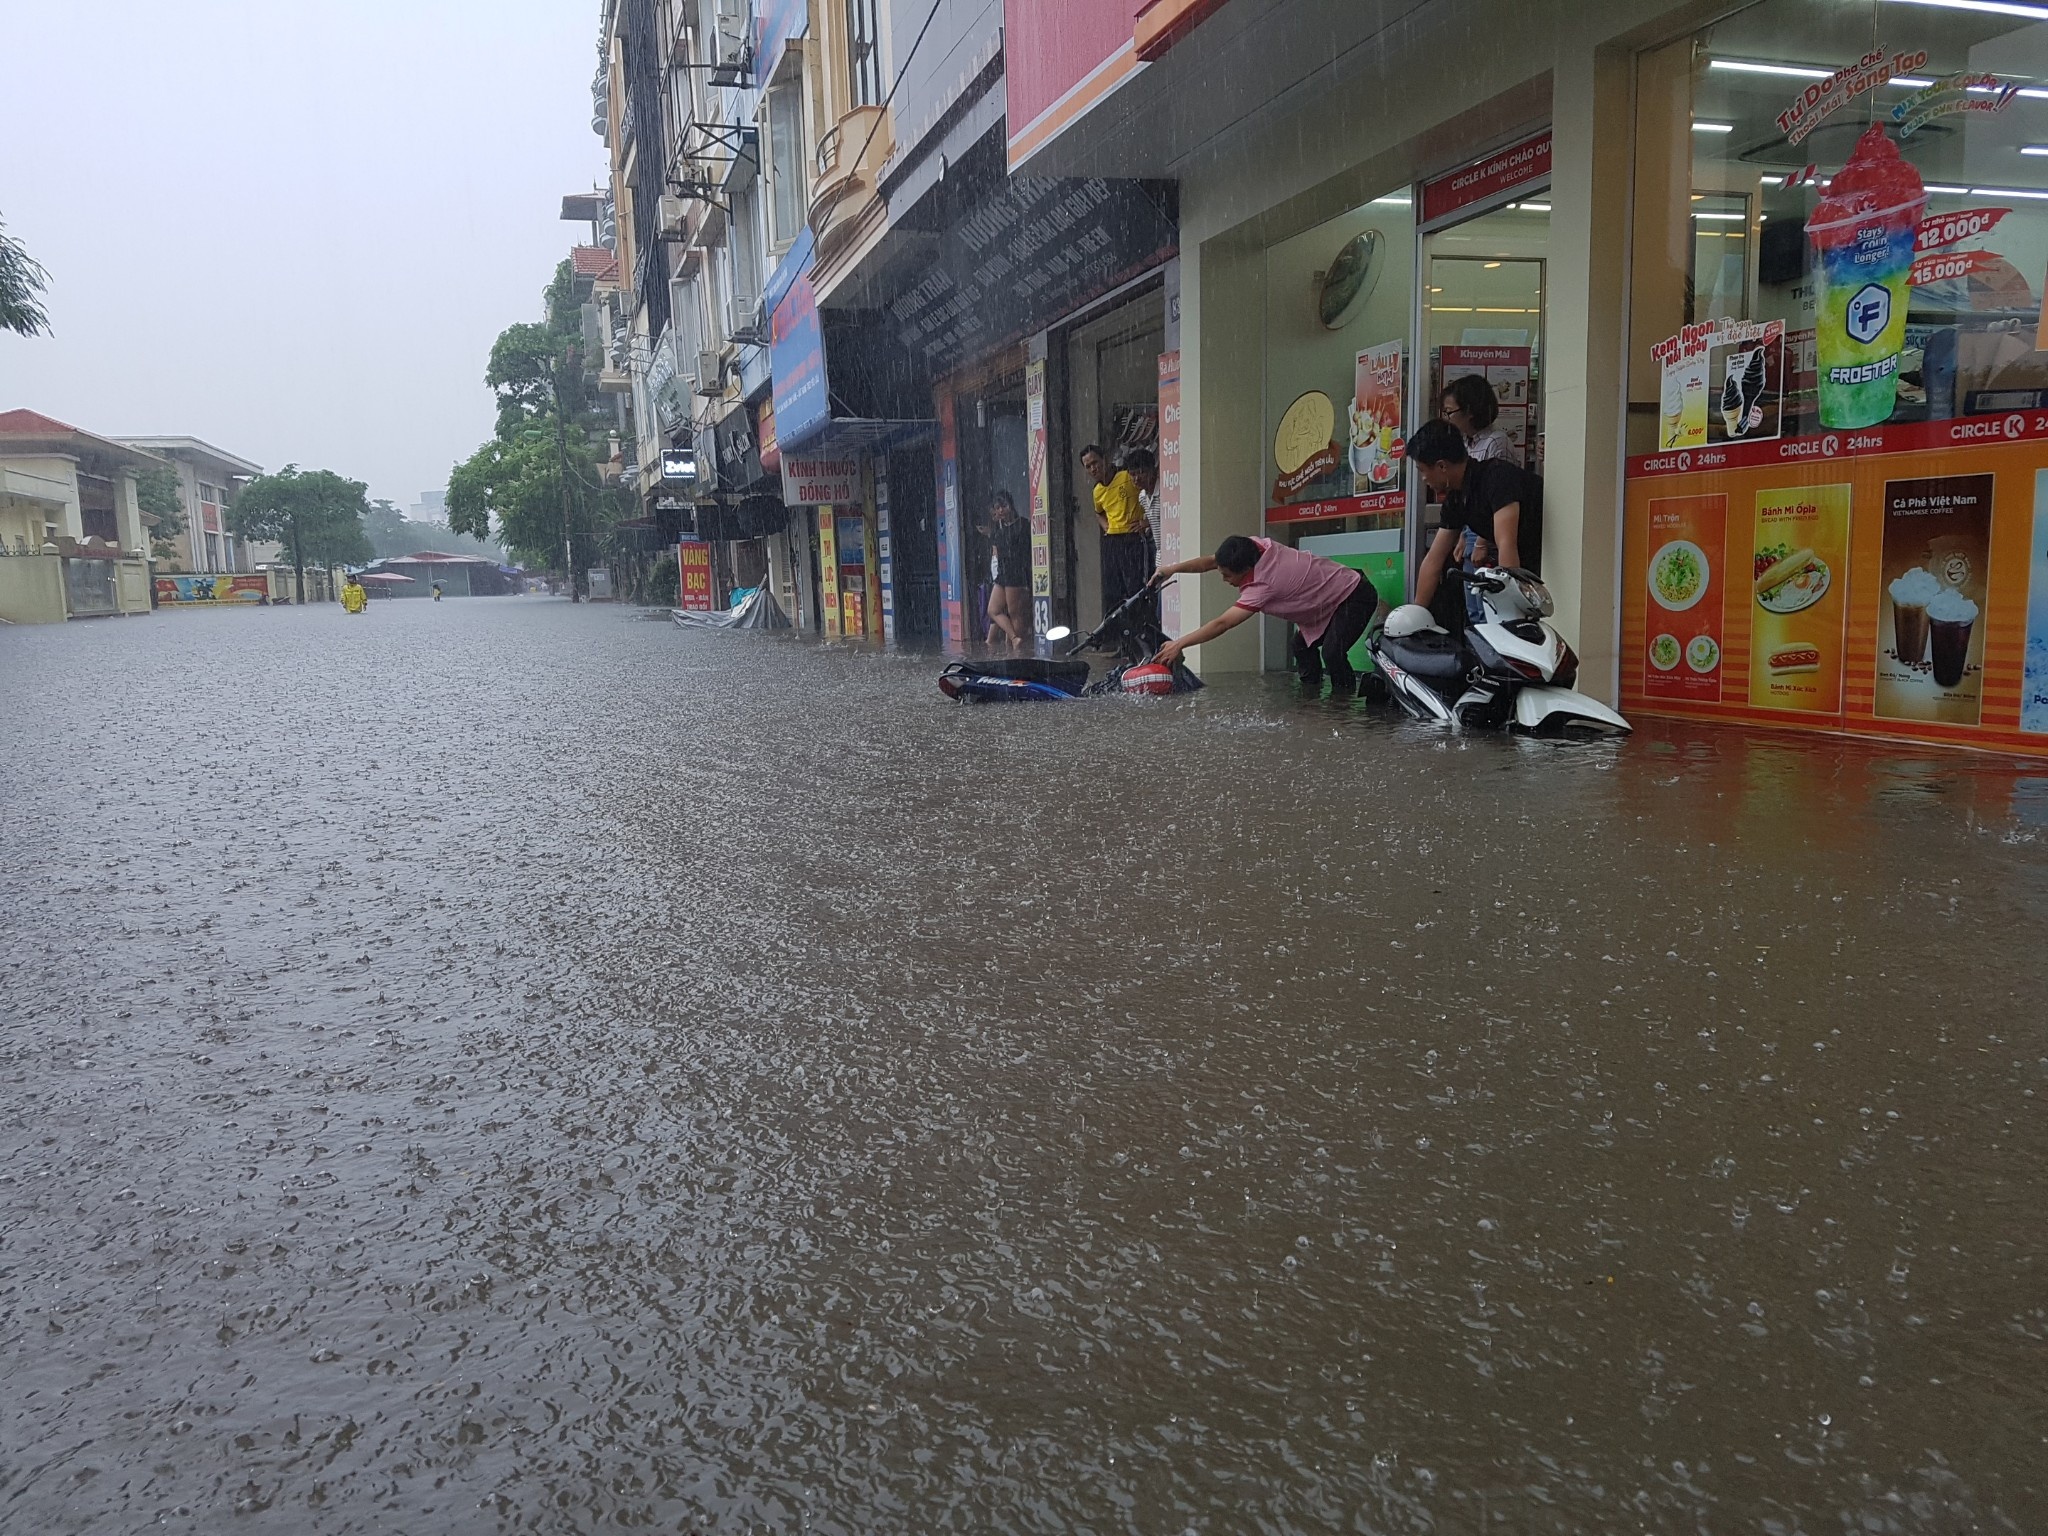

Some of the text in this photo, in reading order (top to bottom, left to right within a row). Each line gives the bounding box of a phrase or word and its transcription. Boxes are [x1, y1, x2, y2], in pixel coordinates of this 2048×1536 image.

[1845, 70, 1890, 99] Sáng
[1892, 51, 1927, 76] Tạo
[1804, 79, 1833, 108] Do
[1892, 99, 1915, 120] MIX
[1452, 171, 1479, 190] CIRCLE
[1481, 170, 1487, 179] K
[1500, 164, 1534, 184] WELCOME
[1857, 227, 1883, 240] Stays
[1855, 246, 1890, 264] Longer!
[1651, 321, 1714, 360] Kem Ngon
[1830, 353, 1898, 384] FROSTER
[1951, 421, 2000, 440] CIRCLE
[2004, 414, 2025, 439] K
[1780, 435, 1883, 457] CIRCLE K 24hrs
[788, 457, 817, 478] KÍNH
[1644, 452, 1726, 471] CIRCLE K 24hrs
[799, 480, 831, 502] ĐỒNG
[1299, 505, 1315, 516] CIRCLE
[1360, 498, 1378, 509] CIRCLE
[1762, 507, 1782, 517] Bánh
[1893, 496, 1977, 509] Cà Phê Việt Nam
[1893, 507, 1954, 517] VIETNAMESE COFFEE
[1664, 512, 1680, 523] Trộn
[682, 545, 708, 566] VÀNG
[687, 572, 706, 593] BẠC
[1035, 600, 1049, 634] 83
[1481, 677, 1500, 687] HONDA
